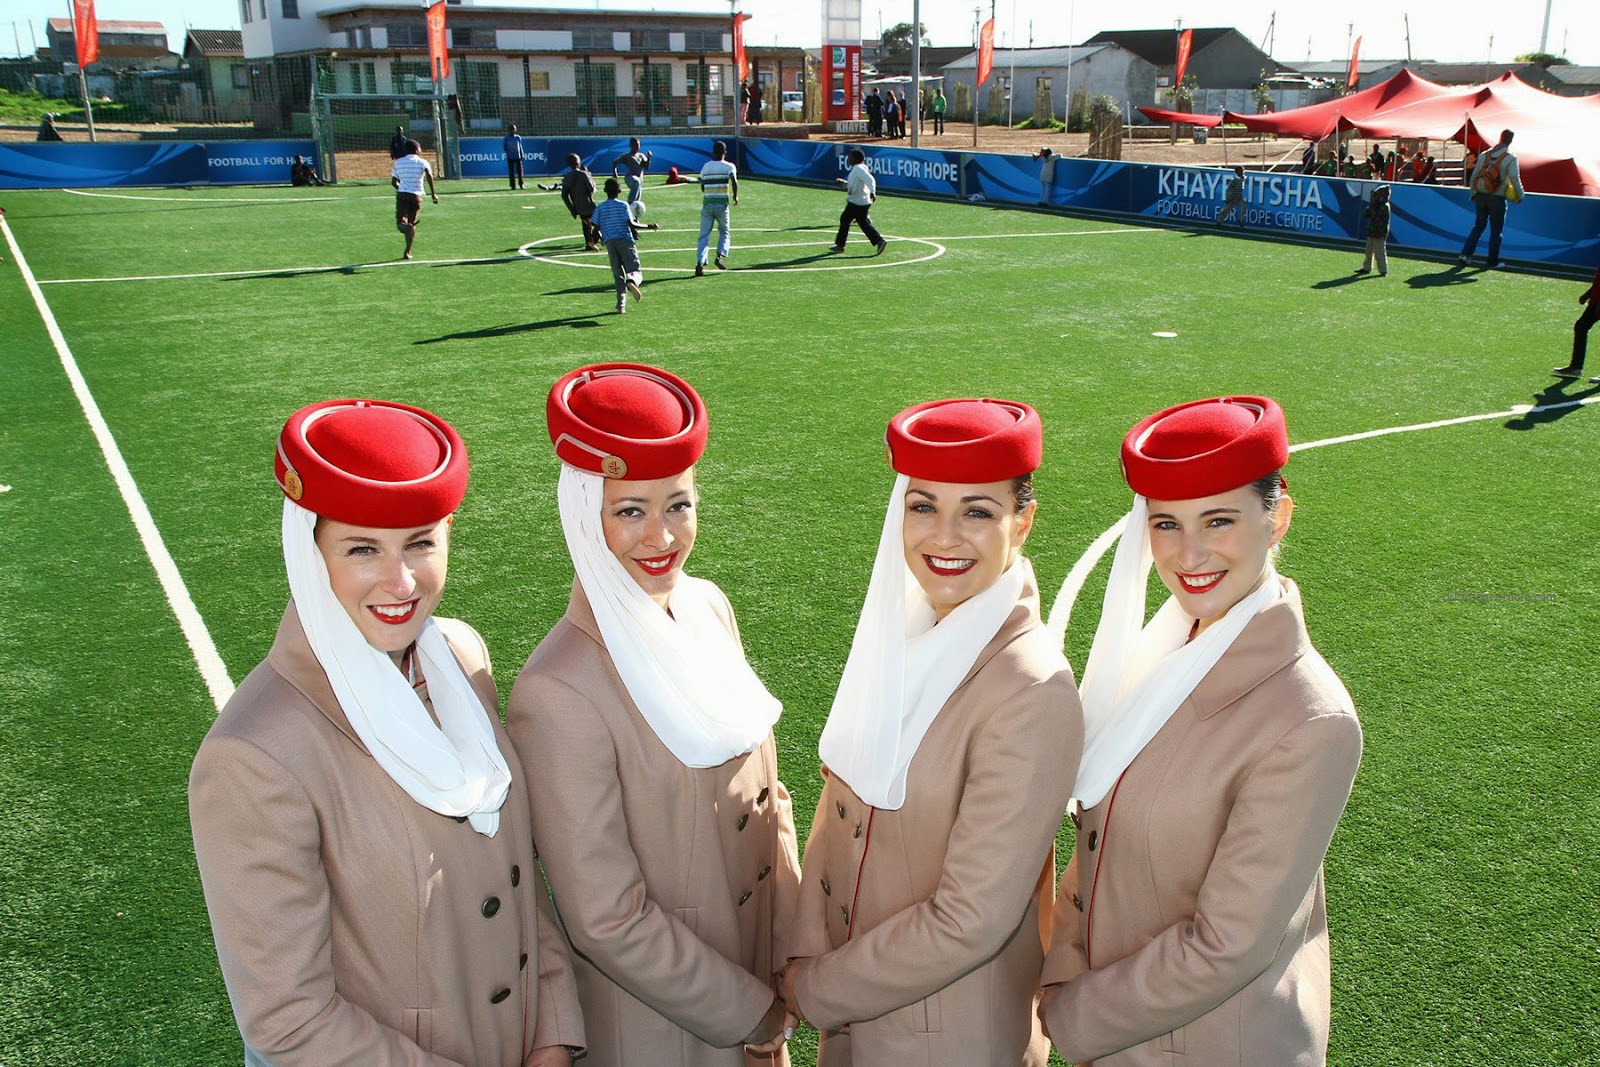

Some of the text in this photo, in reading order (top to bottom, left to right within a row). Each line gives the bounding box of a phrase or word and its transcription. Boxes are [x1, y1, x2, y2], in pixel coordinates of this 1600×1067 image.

[208, 156, 314, 167] FOOTBALL FOR HPE
[460, 153, 499, 162] OOTBALL
[838, 155, 958, 182] FOBALL FOR HOPE
[1157, 200, 1211, 220] FOOTBALL
[1275, 211, 1323, 230] CENTRE
